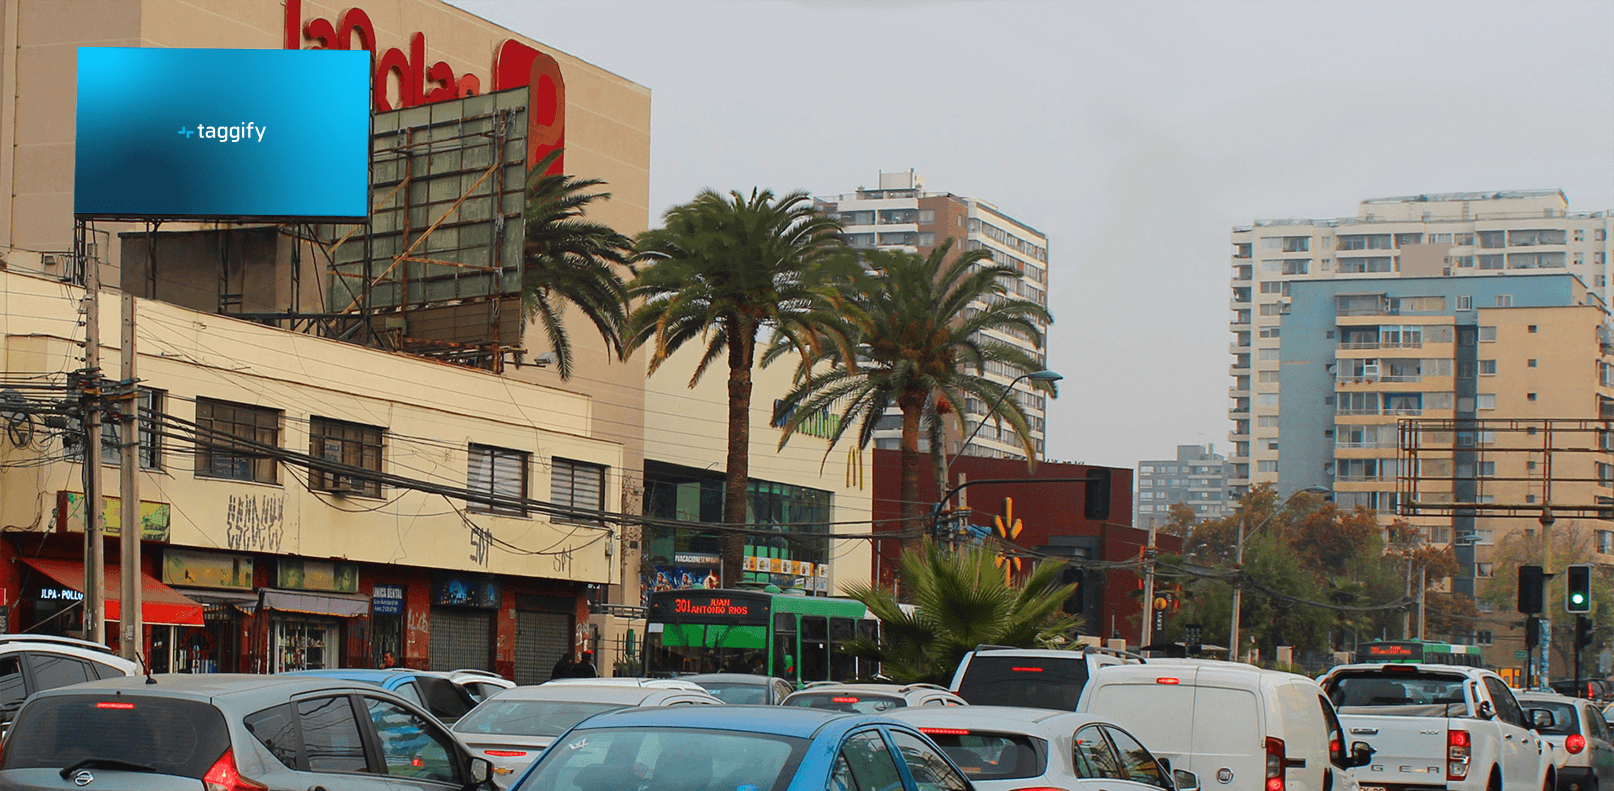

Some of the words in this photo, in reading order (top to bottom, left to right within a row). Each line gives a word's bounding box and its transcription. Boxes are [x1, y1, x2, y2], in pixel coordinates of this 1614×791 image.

[197, 121, 266, 143] taggify
[675, 598, 691, 613] 301
[710, 598, 731, 607] JUAN
[690, 605, 726, 614] ANTONIO
[728, 606, 749, 615] RIOS
